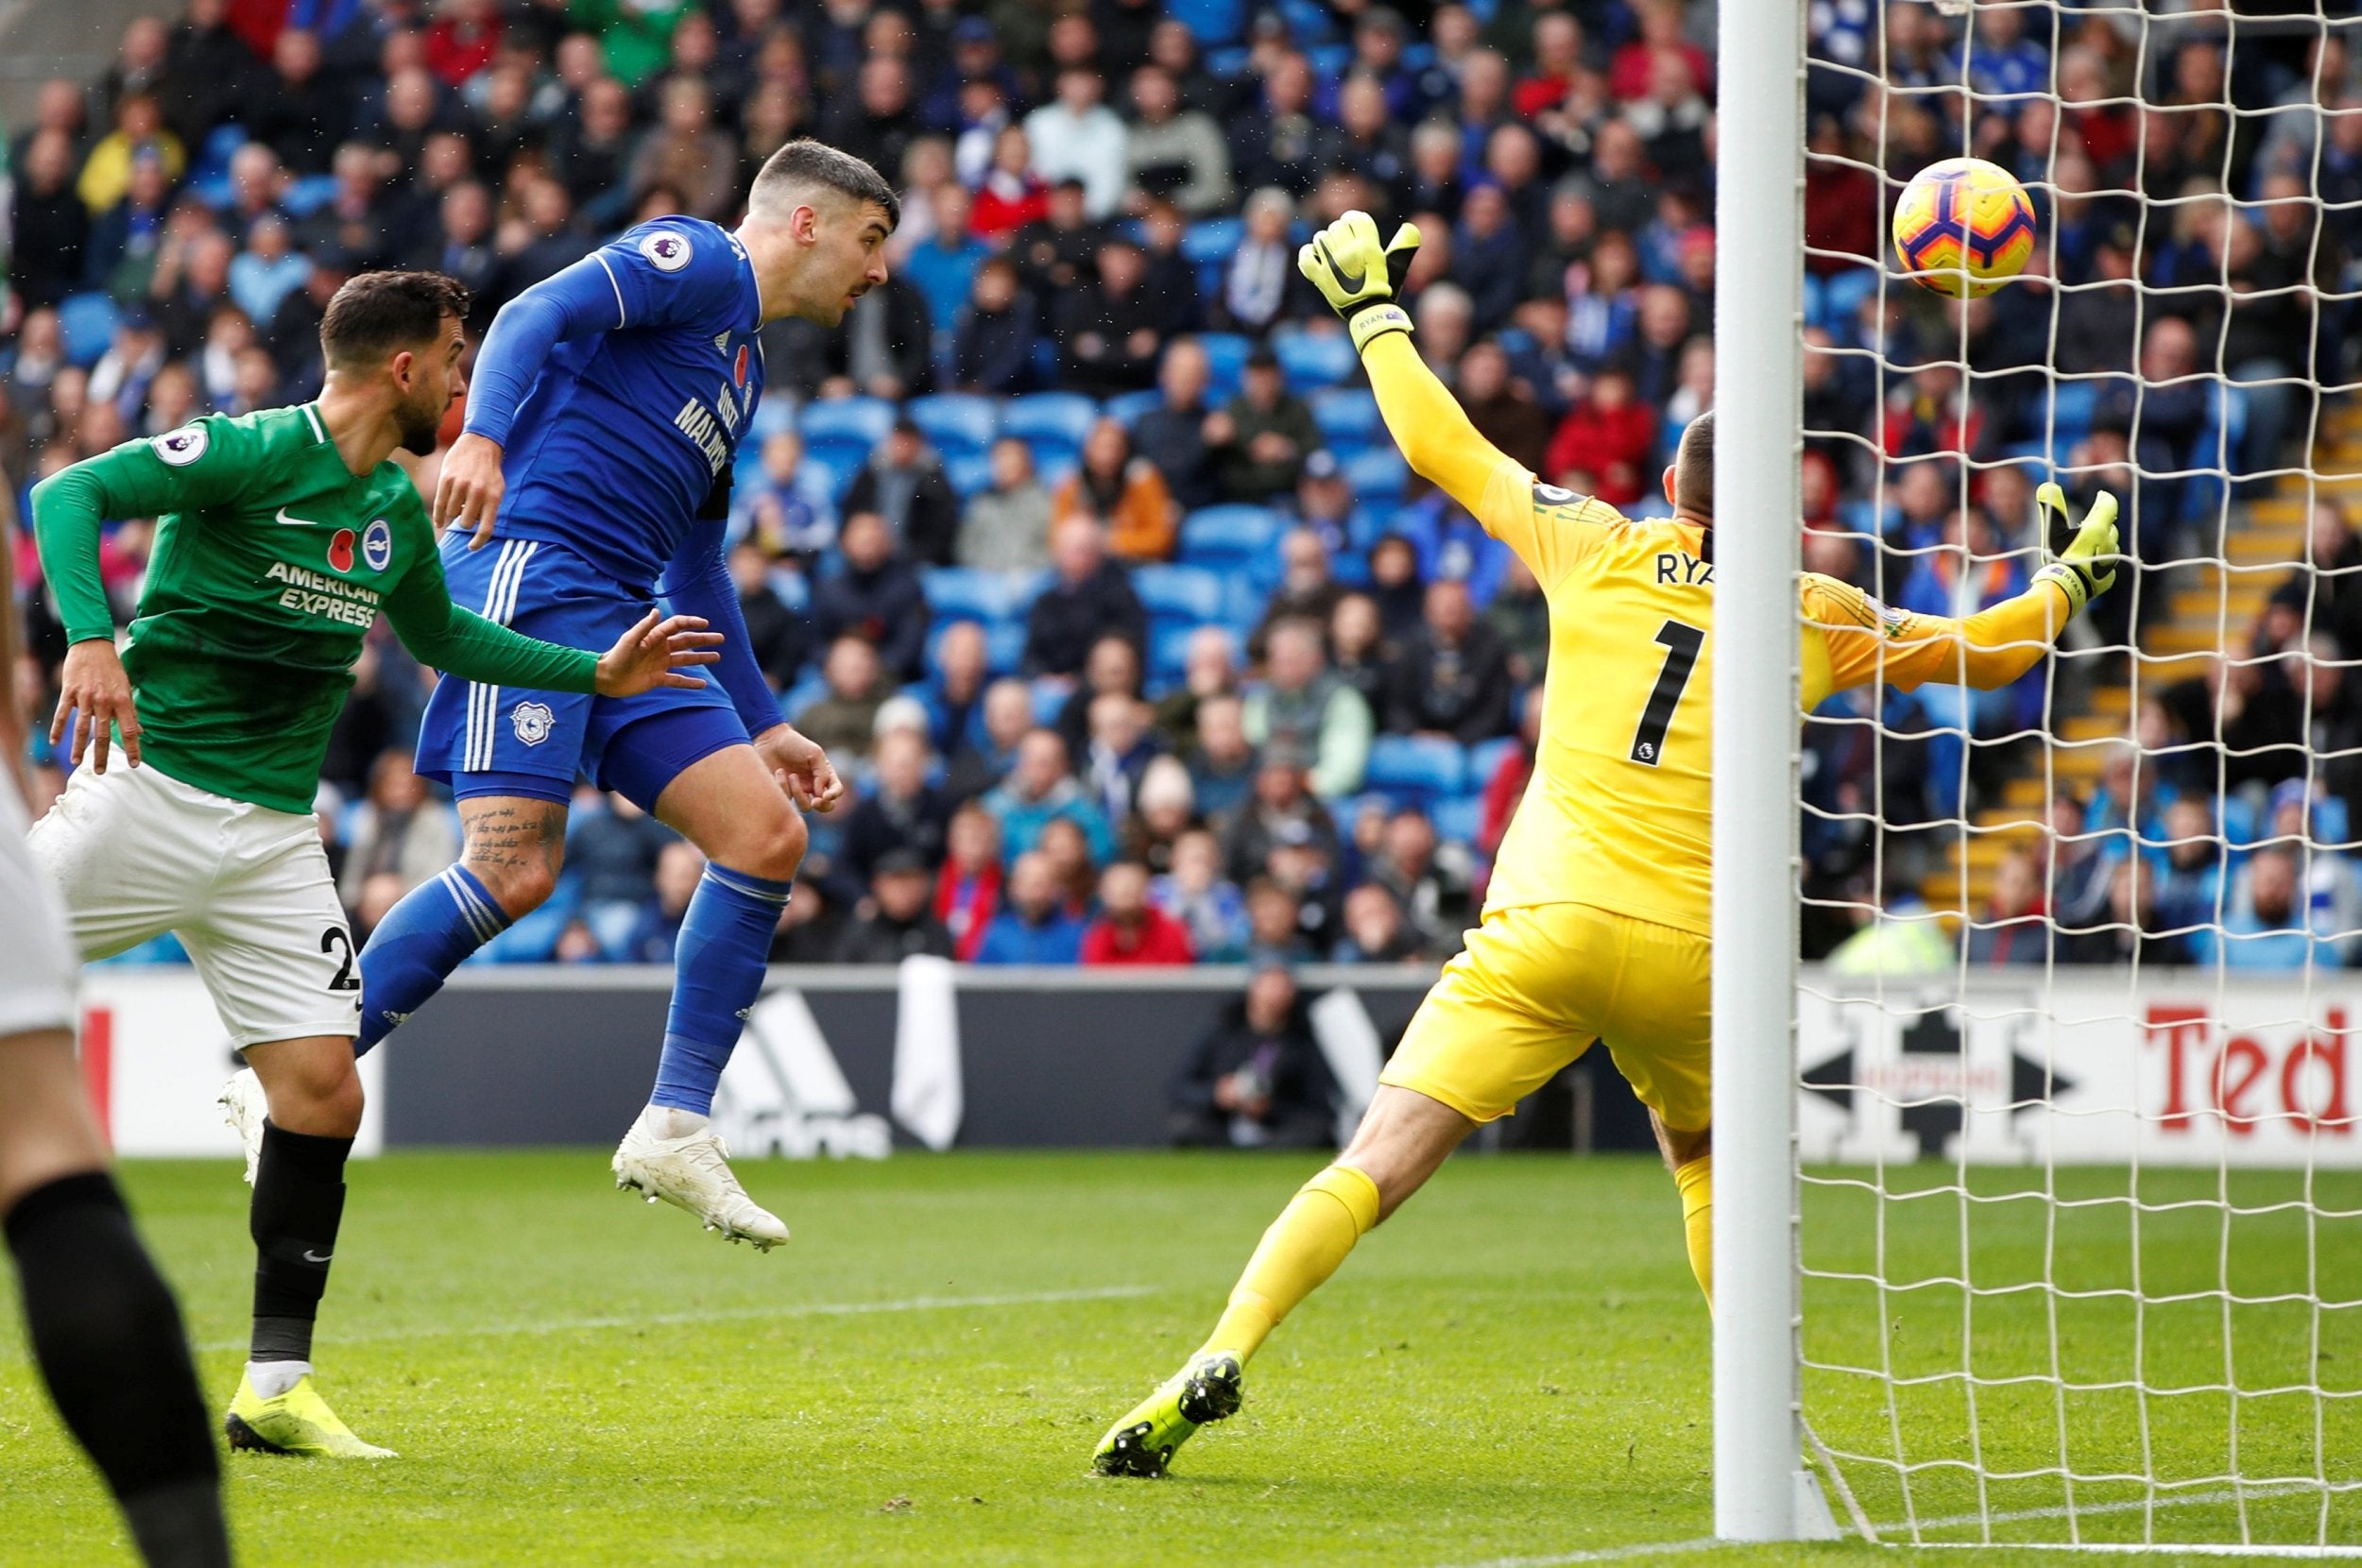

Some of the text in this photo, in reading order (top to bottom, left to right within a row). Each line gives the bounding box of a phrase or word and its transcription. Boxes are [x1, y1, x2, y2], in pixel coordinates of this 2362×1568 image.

[1359, 313, 1384, 331] RYAN
[264, 561, 380, 605] AMERICAN
[1656, 552, 1715, 586] RYA
[278, 588, 376, 629] EXPRESS
[1630, 620, 1705, 768] 1
[320, 926, 361, 991] 2
[2143, 1003, 2353, 1135] Ted
